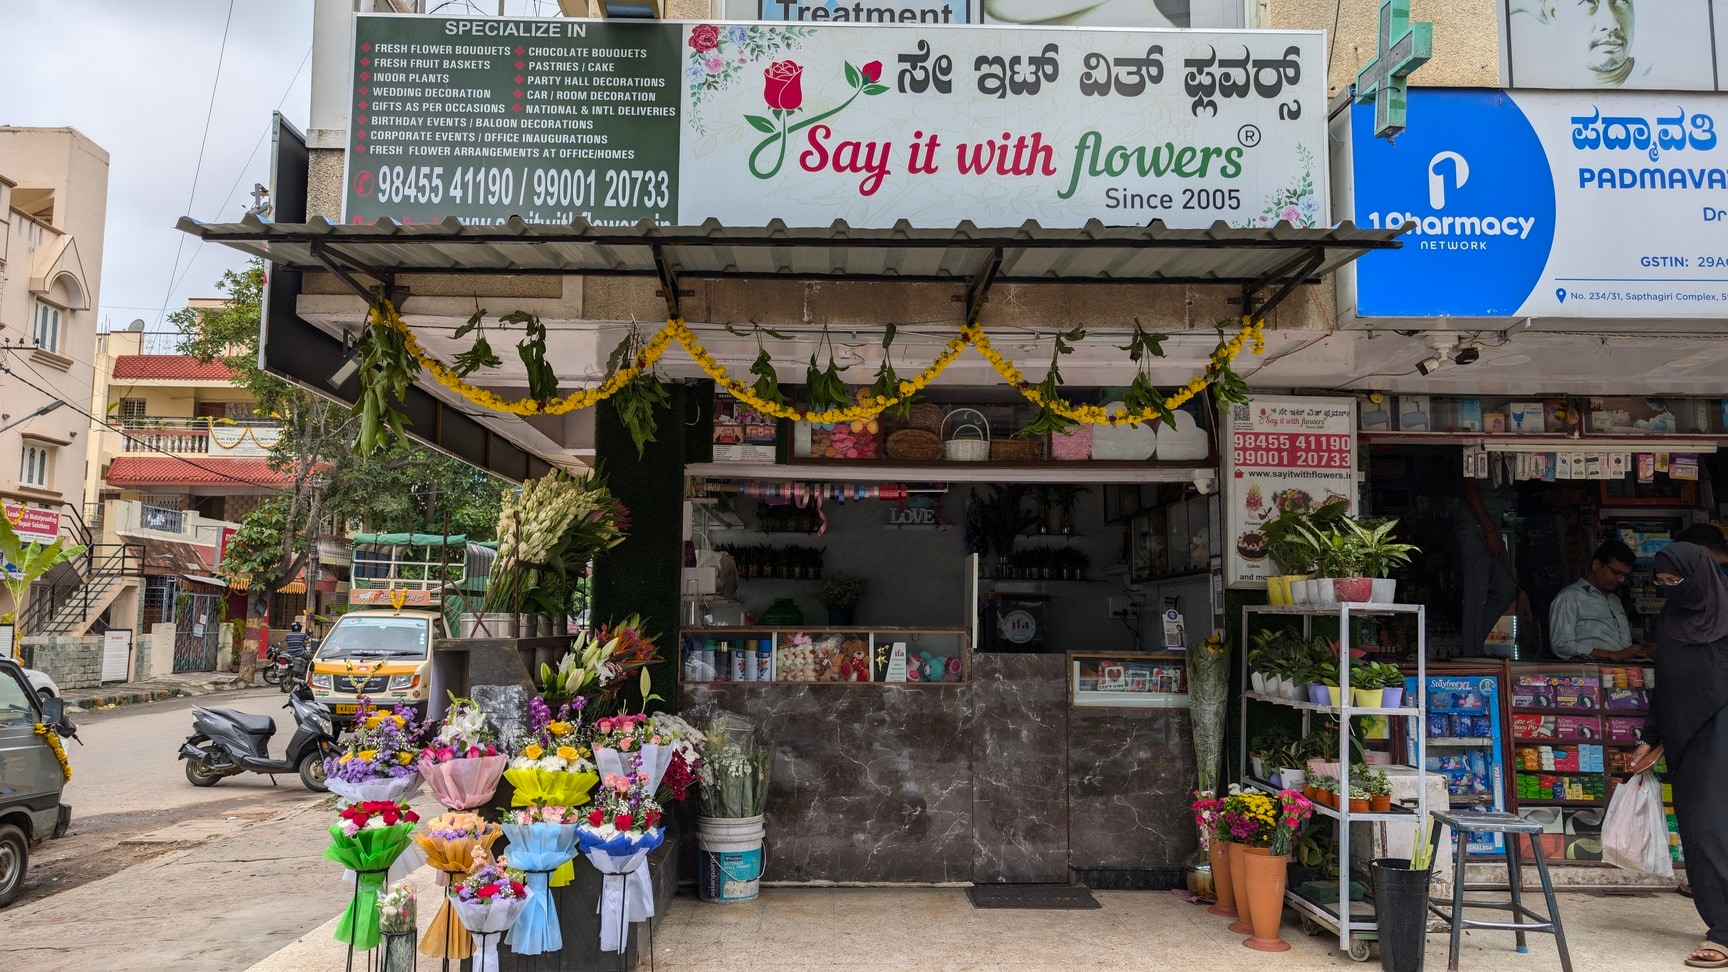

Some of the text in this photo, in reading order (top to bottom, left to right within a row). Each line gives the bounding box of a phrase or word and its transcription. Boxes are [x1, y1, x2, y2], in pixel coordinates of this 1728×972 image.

[445, 21, 586, 38] SPECIALIZE IN
[375, 44, 511, 56] FRESH FLOWER BOUQUETS
[528, 47, 648, 58] CHOCOLATE BOUQUETS
[374, 58, 491, 70] FRESH FRUIT BASKETS
[528, 61, 579, 71] PASTRIES
[588, 62, 615, 72] CAKE
[897, 39, 953, 94] ಸೇ
[974, 43, 1059, 99] ಇಟ್
[1079, 44, 1164, 98] ವಿತ್
[373, 73, 450, 83] INOOR PLANTS
[527, 76, 666, 87] PARTY HALL DECORATIONS
[373, 87, 491, 98] WEDDING DECORATION
[527, 90, 548, 100] CAR
[556, 91, 587, 100] ROOM
[590, 91, 656, 102] DECORATION
[372, 101, 506, 113] GIFTS AS PER OCCASIONS
[526, 104, 676, 116] NATIONAL & INTL DELIVERIES
[371, 116, 424, 126] BIRTHDAY
[427, 117, 467, 127] EVENTS
[475, 118, 518, 128] BALOON
[520, 119, 594, 129] DECORATIONS
[370, 131, 433, 141] CORPORATE
[435, 132, 476, 142] EVENTS
[484, 133, 519, 143] OFFICE
[522, 133, 608, 144] INAUGURATIONS
[370, 145, 635, 159] FRESH FLOWER ARRANGEMENTS AT OFFICE/HOMES
[799, 124, 892, 197] Say
[907, 130, 941, 175] it
[956, 131, 1057, 177] with
[1578, 168, 1728, 190] PADMAVA
[378, 165, 669, 208] 98455 41190 / 99001 20733
[1105, 188, 1241, 210] Since 2005
[1420, 240, 1487, 250] NETWORK
[1640, 256, 1689, 268] GSTIN:
[1570, 292, 1587, 300] No.
[1589, 292, 1623, 302] 234/31,
[1625, 292, 1673, 303] Sapthagiri
[1675, 292, 1719, 303] Complex,
[1265, 416, 1278, 427] Say
[1279, 417, 1285, 425] it
[1285, 417, 1300, 425] with
[1234, 434, 1351, 450] 98455 41190
[1234, 450, 1351, 466] 99001 20733
[889, 507, 935, 523] LOVE
[32, 521, 50, 530] Solutions
[1430, 679, 1459, 689] Stayfree
[1458, 681, 1472, 691] XL
